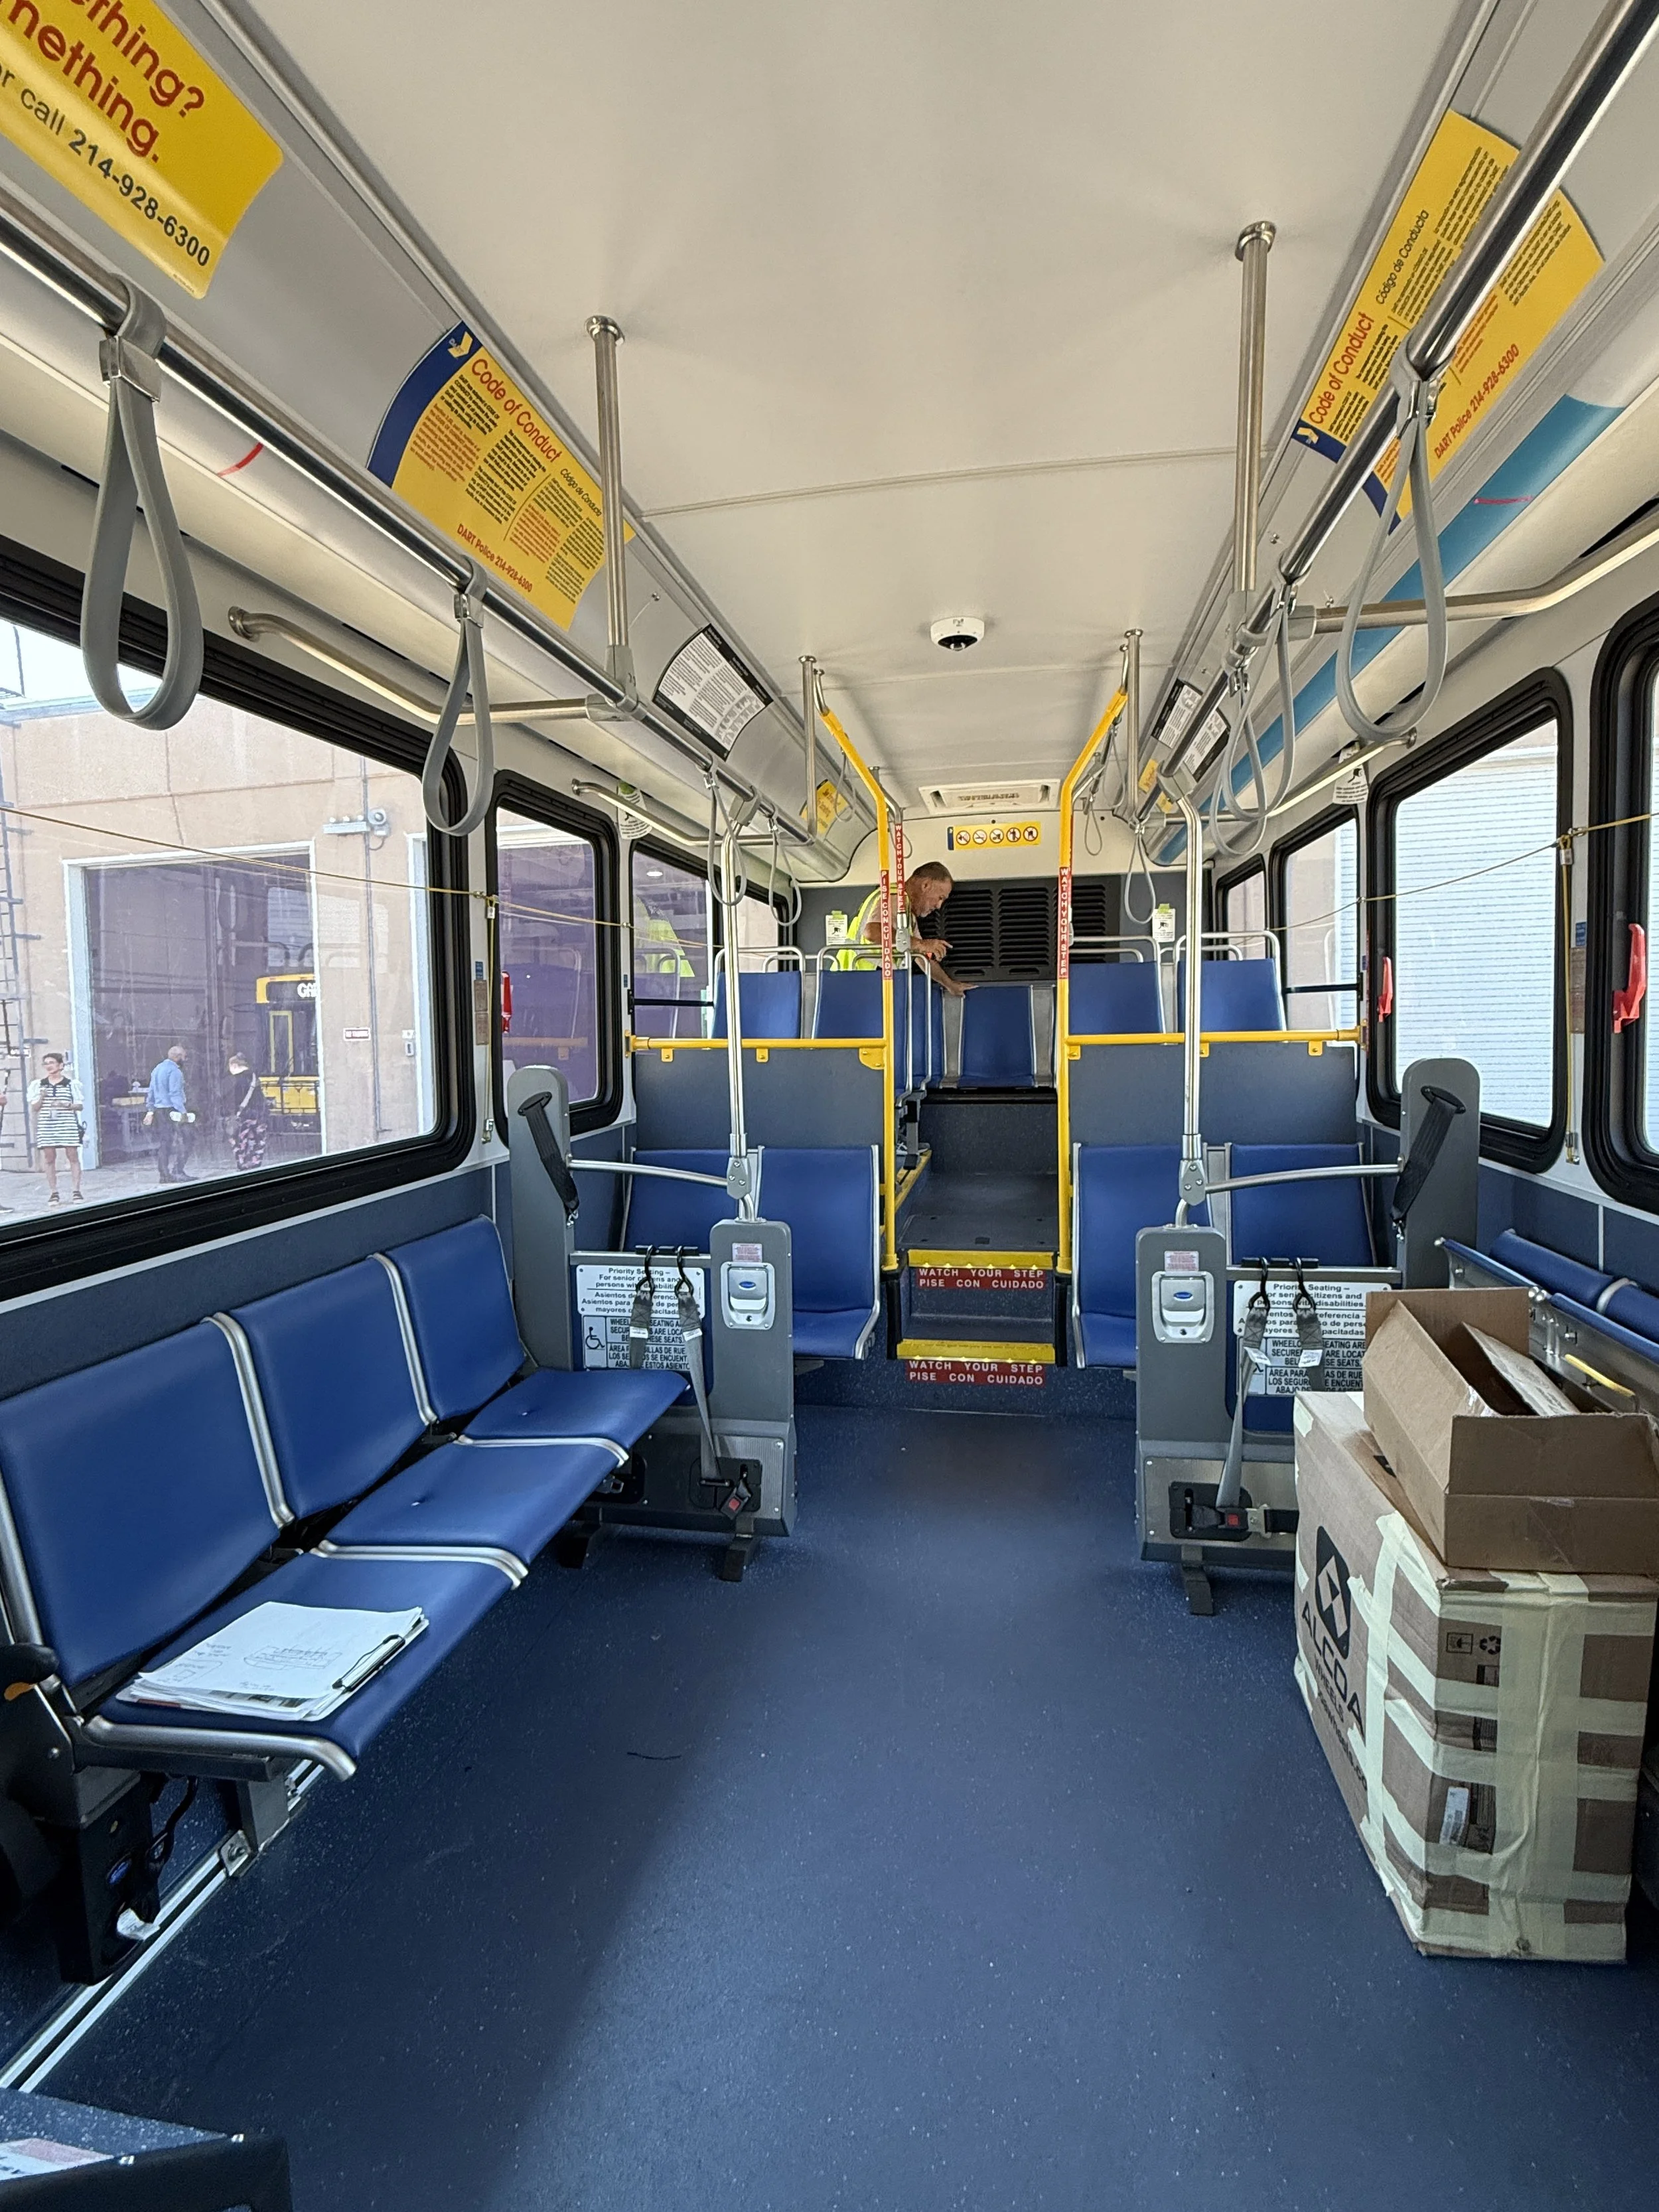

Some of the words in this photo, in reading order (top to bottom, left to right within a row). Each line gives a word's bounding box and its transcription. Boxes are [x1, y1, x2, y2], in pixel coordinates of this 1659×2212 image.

[21, 88, 64, 135] call
[68, 128, 210, 267] 214-928-6300
[1376, 273, 1397, 304] Código
[1394, 259, 1404, 272] de
[1399, 210, 1429, 258] Conducta
[1334, 312, 1375, 370] Conduct
[1309, 392, 1334, 423] Code
[1329, 372, 1343, 390] of
[1434, 433, 1455, 459] DART
[1450, 409, 1471, 437] Police
[1470, 344, 1519, 412] 214-928-6300
[472, 359, 506, 400] Code
[504, 400, 523, 415] of
[516, 411, 562, 463] Conduct
[561, 469, 578, 488] Código
[457, 524, 476, 544] DART
[475, 539, 494, 561] Police
[495, 556, 532, 592] 214-928-6300
[883, 926, 891, 976] CUIDADO
[992, 1280, 1044, 1289] CUIDADO
[908, 1361, 952, 1370] WATCH
[964, 1362, 998, 1371] YOUR
[1011, 1364, 1043, 1373] STEP
[909, 1372, 936, 1381] PISE
[949, 1373, 975, 1382] CON
[987, 1374, 1043, 1384] CUIDADO
[1302, 1601, 1366, 1747] ALCOA
[1314, 1654, 1344, 1723] WHEELS
